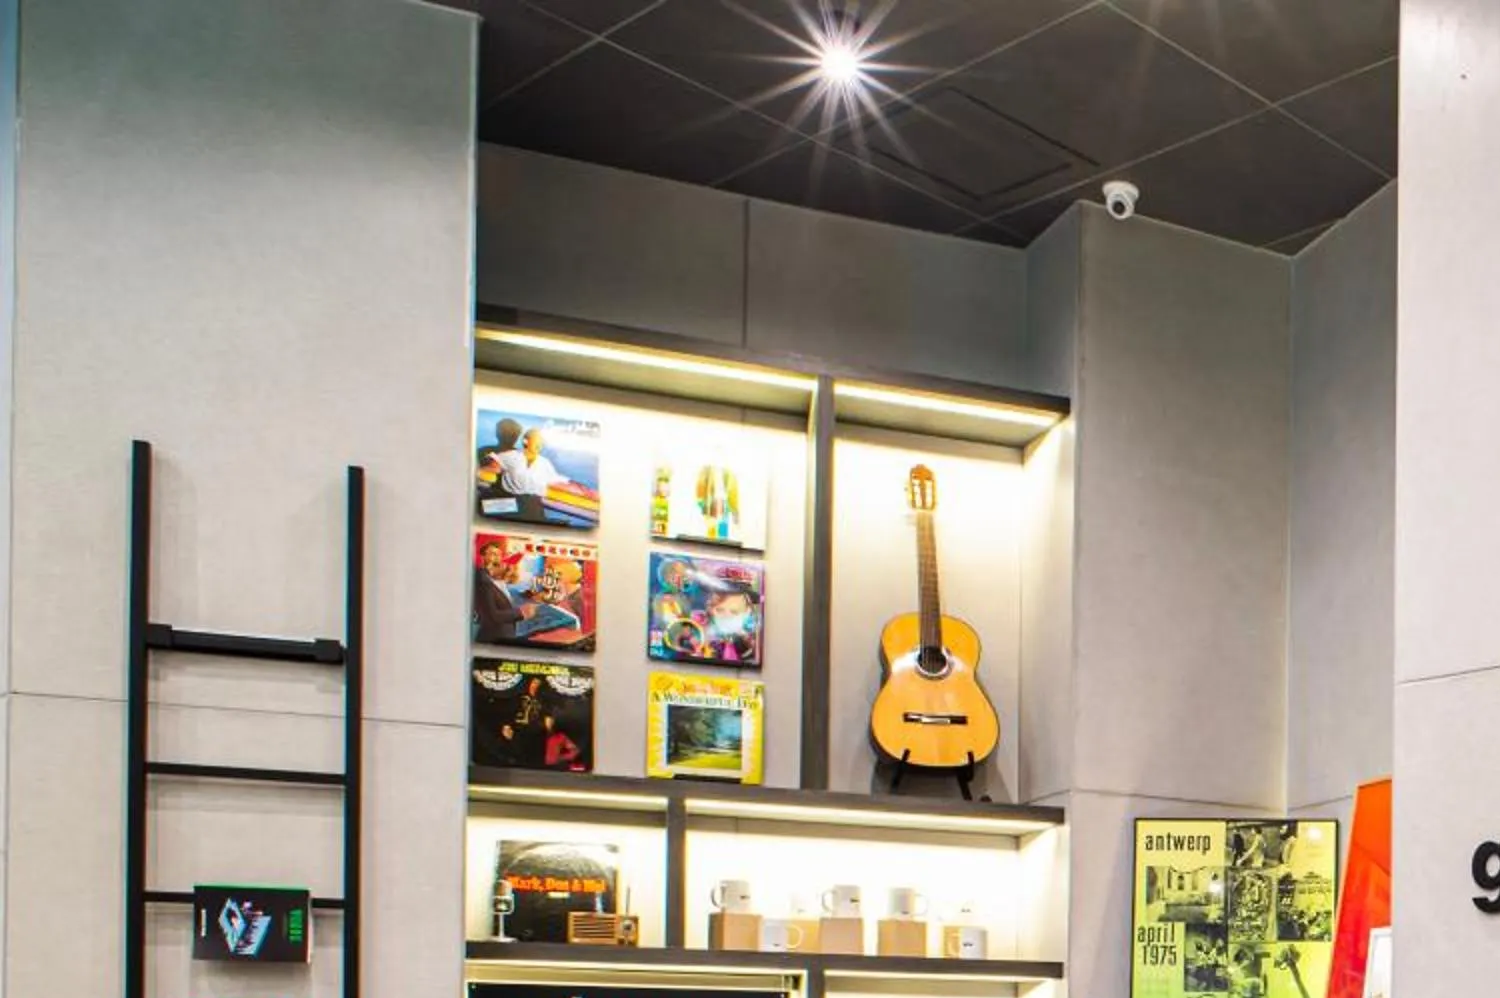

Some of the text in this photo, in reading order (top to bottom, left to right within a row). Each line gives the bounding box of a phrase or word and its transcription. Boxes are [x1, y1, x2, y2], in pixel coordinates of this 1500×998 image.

[1145, 833, 1211, 852] antwerp
[1137, 923, 1175, 949] april
[1142, 945, 1177, 966] 1975
